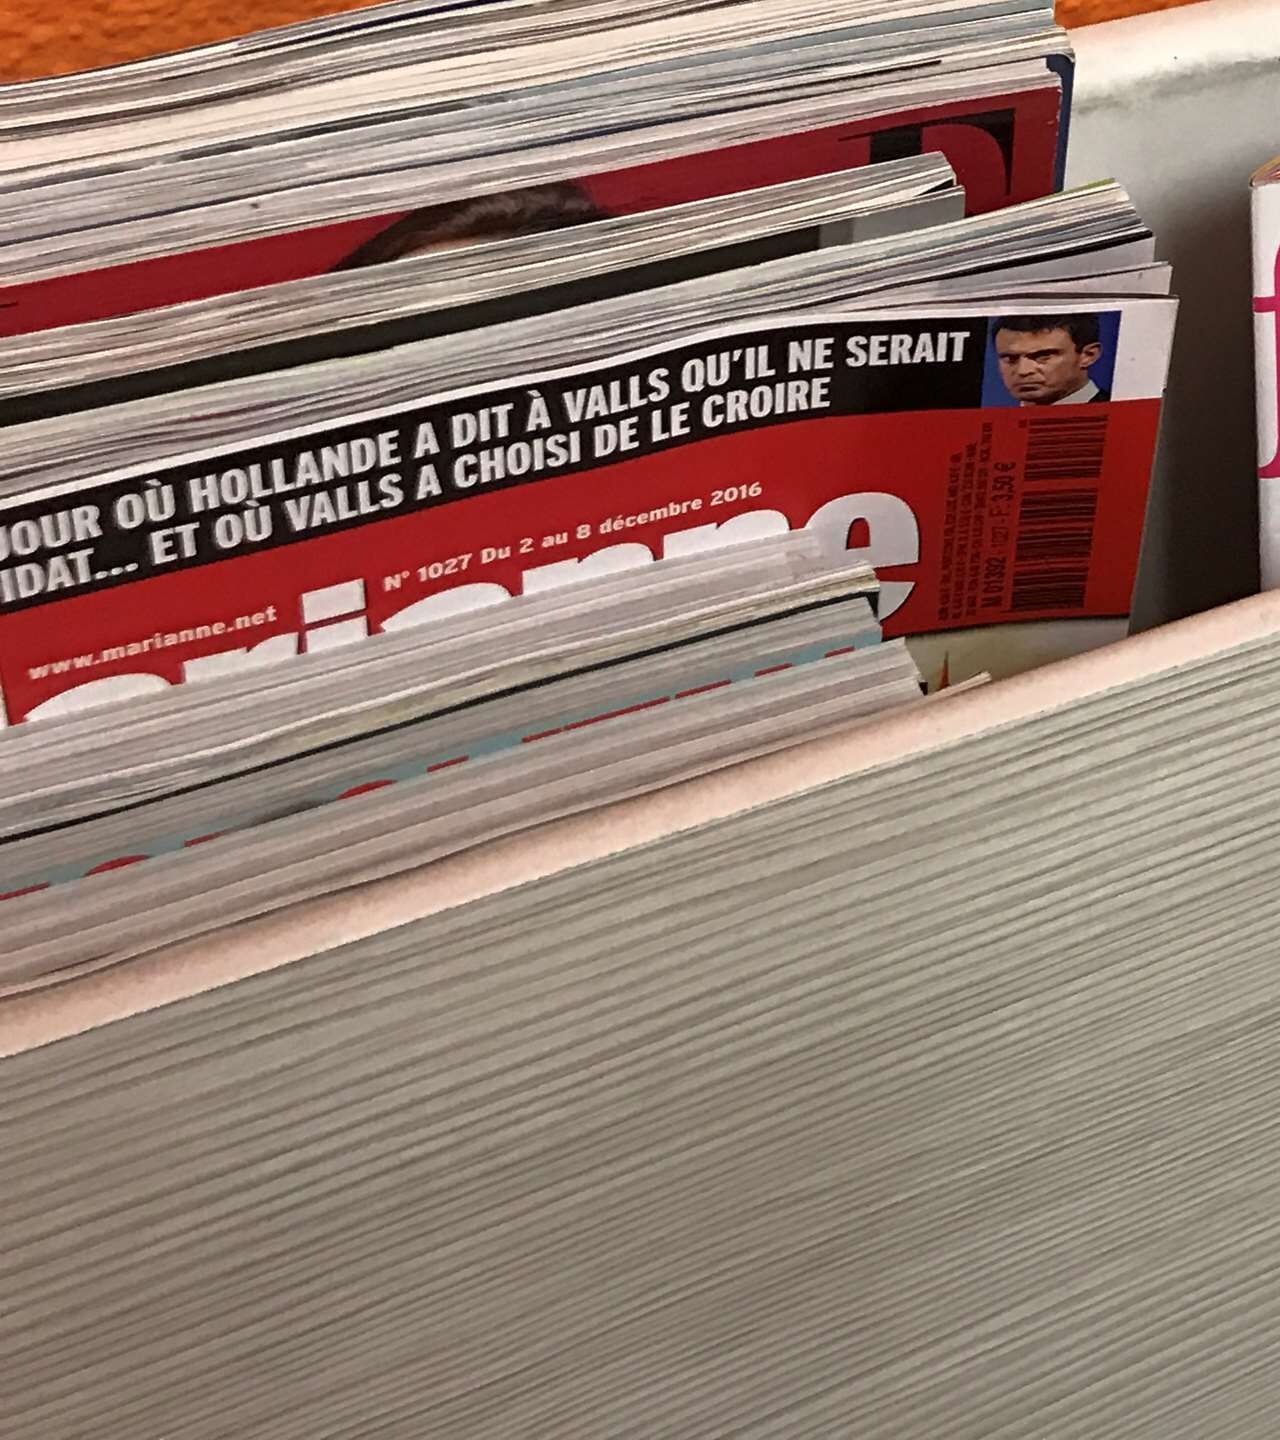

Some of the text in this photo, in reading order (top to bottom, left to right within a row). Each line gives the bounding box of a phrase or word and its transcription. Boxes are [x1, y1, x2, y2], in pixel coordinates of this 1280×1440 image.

[115, 478, 177, 530] OÙ
[188, 428, 403, 513] HOLLANDE
[414, 421, 441, 461] A
[451, 402, 514, 451] DIT
[526, 390, 552, 434] À
[564, 366, 671, 425] VALLS
[681, 343, 777, 395] QU'IL
[787, 336, 836, 374] NE
[845, 330, 973, 368] SERAIT
[150, 521, 201, 564] ET
[214, 499, 274, 549] OÙ
[285, 473, 405, 532] VALLS
[415, 462, 443, 501] A
[453, 425, 582, 490] CHOISI
[594, 414, 640, 457] DE
[650, 405, 692, 444] LE
[702, 376, 832, 429] CROIRE
[383, 481, 764, 593] N° 1027 Du 2 au 8 décembre 2016
[27, 605, 279, 681] www.marianne.net
